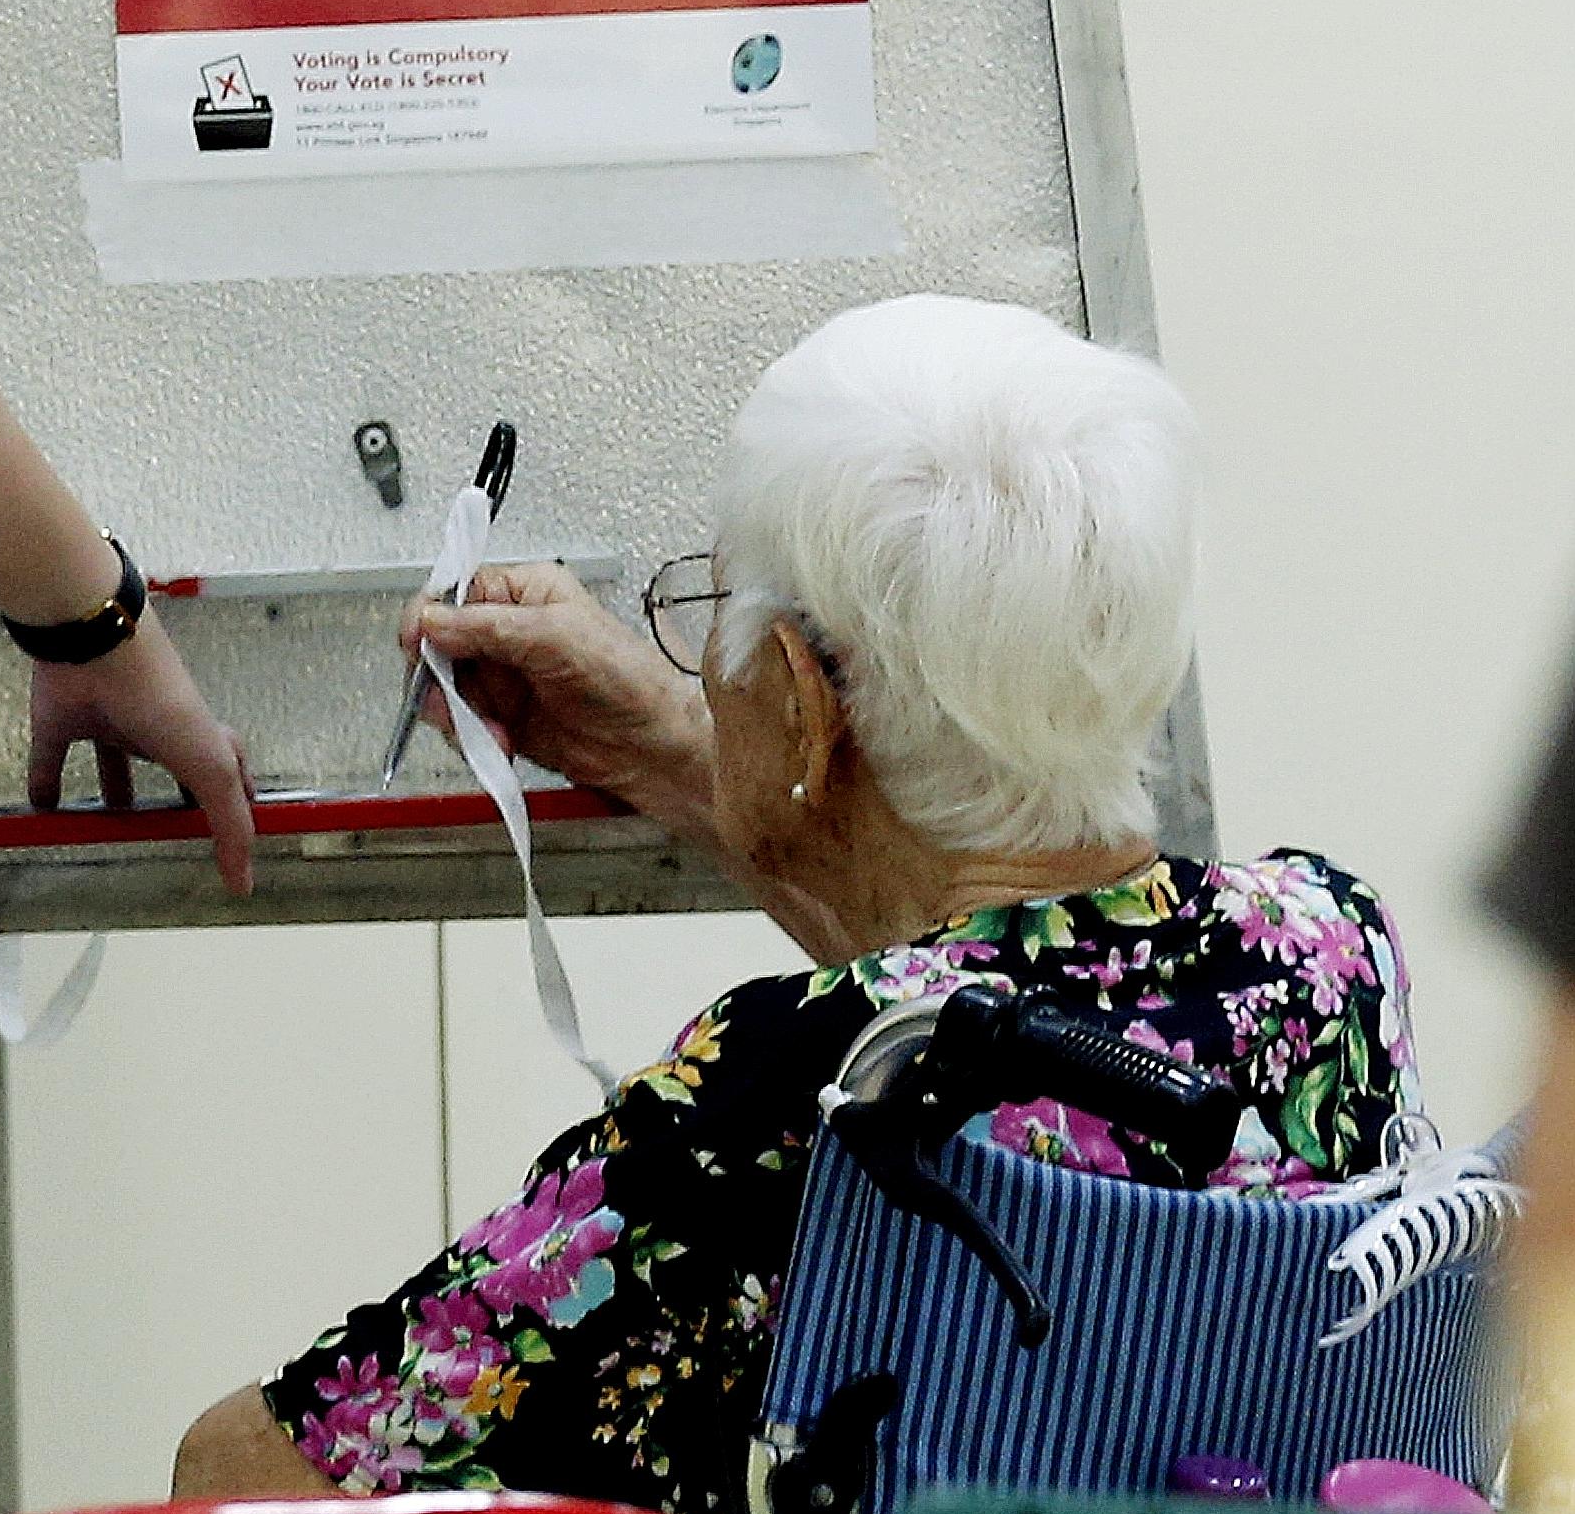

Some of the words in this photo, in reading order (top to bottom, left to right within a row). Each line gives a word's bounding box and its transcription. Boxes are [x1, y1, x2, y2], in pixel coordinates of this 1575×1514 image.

[293, 52, 359, 73] Voting
[388, 45, 508, 67] Compulsory
[294, 76, 338, 93] Your
[346, 74, 393, 91] Vote
[423, 71, 485, 88] Secret
